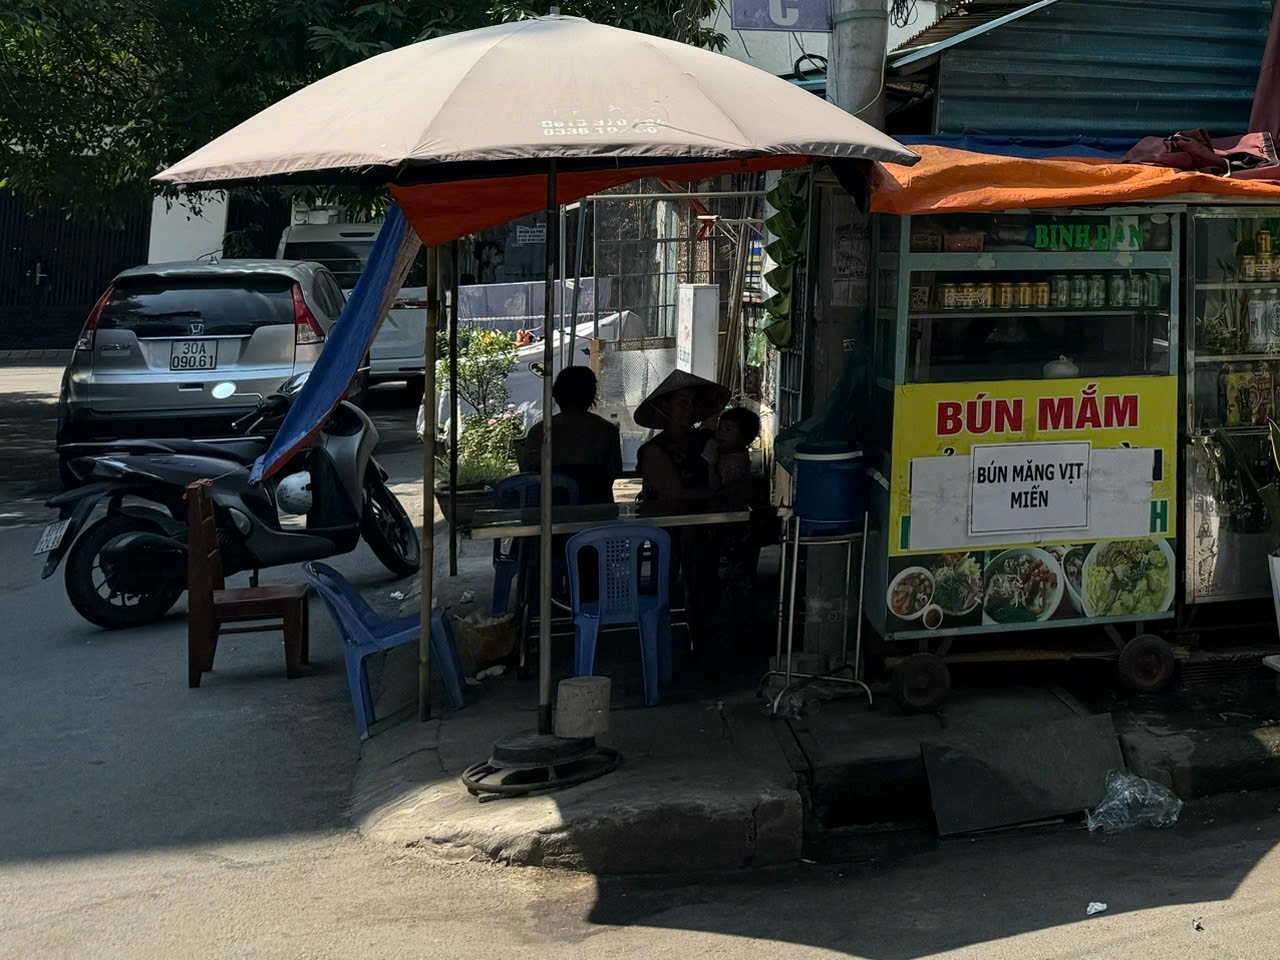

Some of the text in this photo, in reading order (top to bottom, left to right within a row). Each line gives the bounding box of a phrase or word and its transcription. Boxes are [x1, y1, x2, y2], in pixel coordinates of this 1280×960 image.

[183, 342, 206, 355] 30A
[172, 355, 214, 368] 090.61
[936, 384, 1139, 436] BÚN MẮM
[977, 460, 1007, 484] BÚN
[1012, 459, 1055, 483] MĂNG
[1059, 462, 1084, 482] VỊT
[1010, 485, 1049, 509] MIẾN
